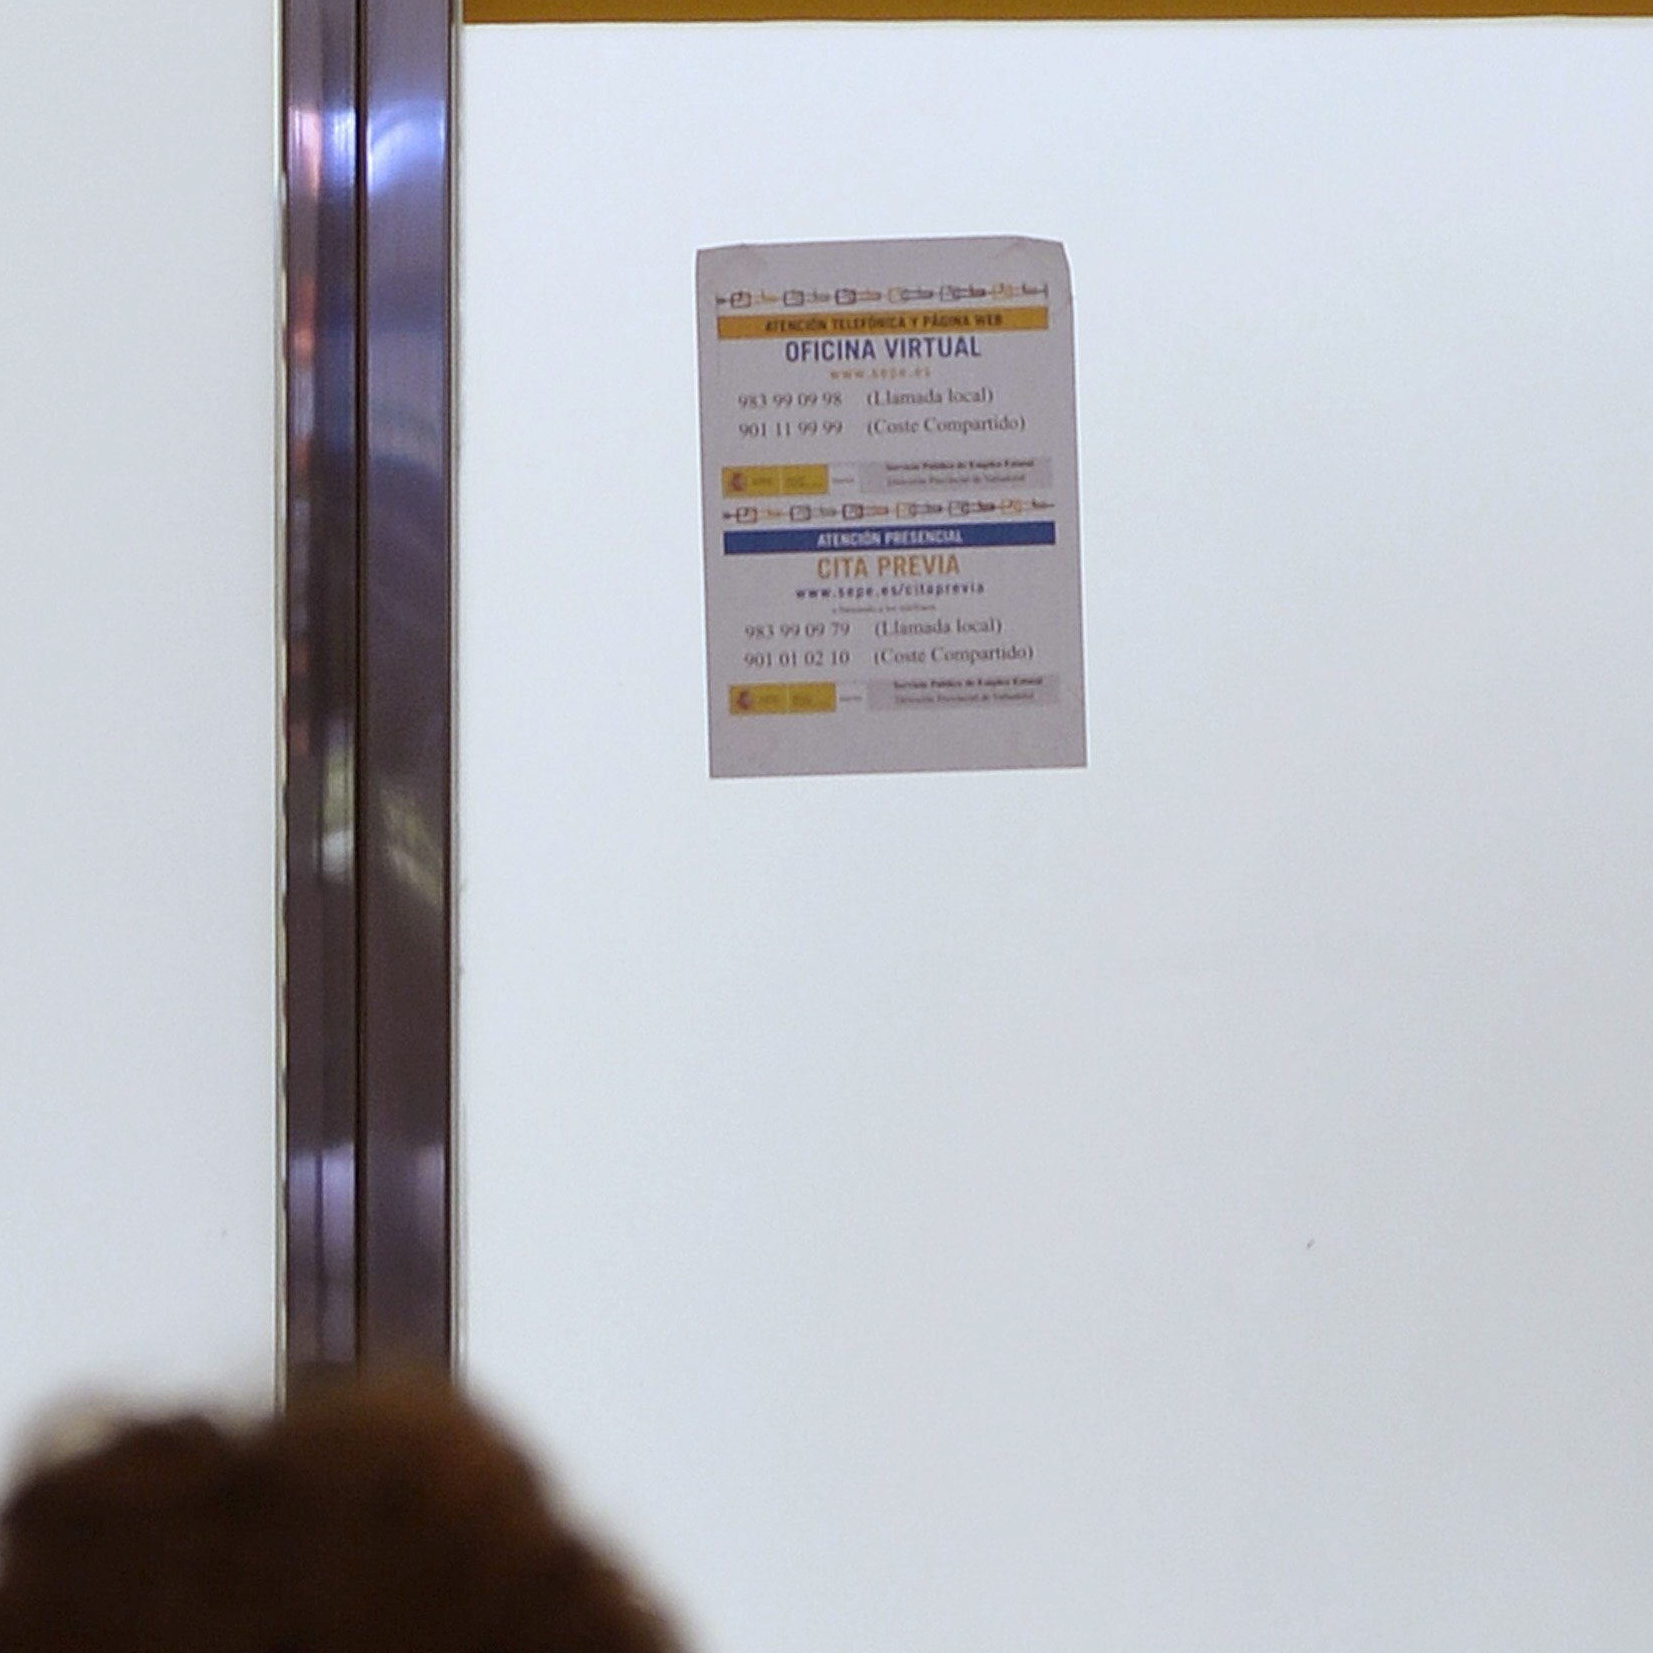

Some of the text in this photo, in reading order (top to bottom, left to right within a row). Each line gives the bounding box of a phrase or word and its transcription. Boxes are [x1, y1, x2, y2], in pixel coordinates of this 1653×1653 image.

[764, 314, 829, 334] ATENCIÓN
[786, 335, 982, 363] OFICINA VIRTUAL
[867, 390, 942, 406] (Llamada
[948, 387, 994, 404] local)
[738, 422, 767, 438] 901
[776, 422, 792, 436] 11
[867, 418, 920, 436] (Coste
[924, 415, 1026, 435] Compartido)
[817, 527, 963, 548] ATENCIÓN PRESENCIAL
[816, 553, 960, 580] CITA PREVIA
[795, 581, 985, 600] www.sepe.es/citaprevia
[874, 620, 950, 637] (Llamada
[956, 618, 1002, 634] local)
[745, 645, 1033, 667] 901 01 02 10 (Coste Compartido)
